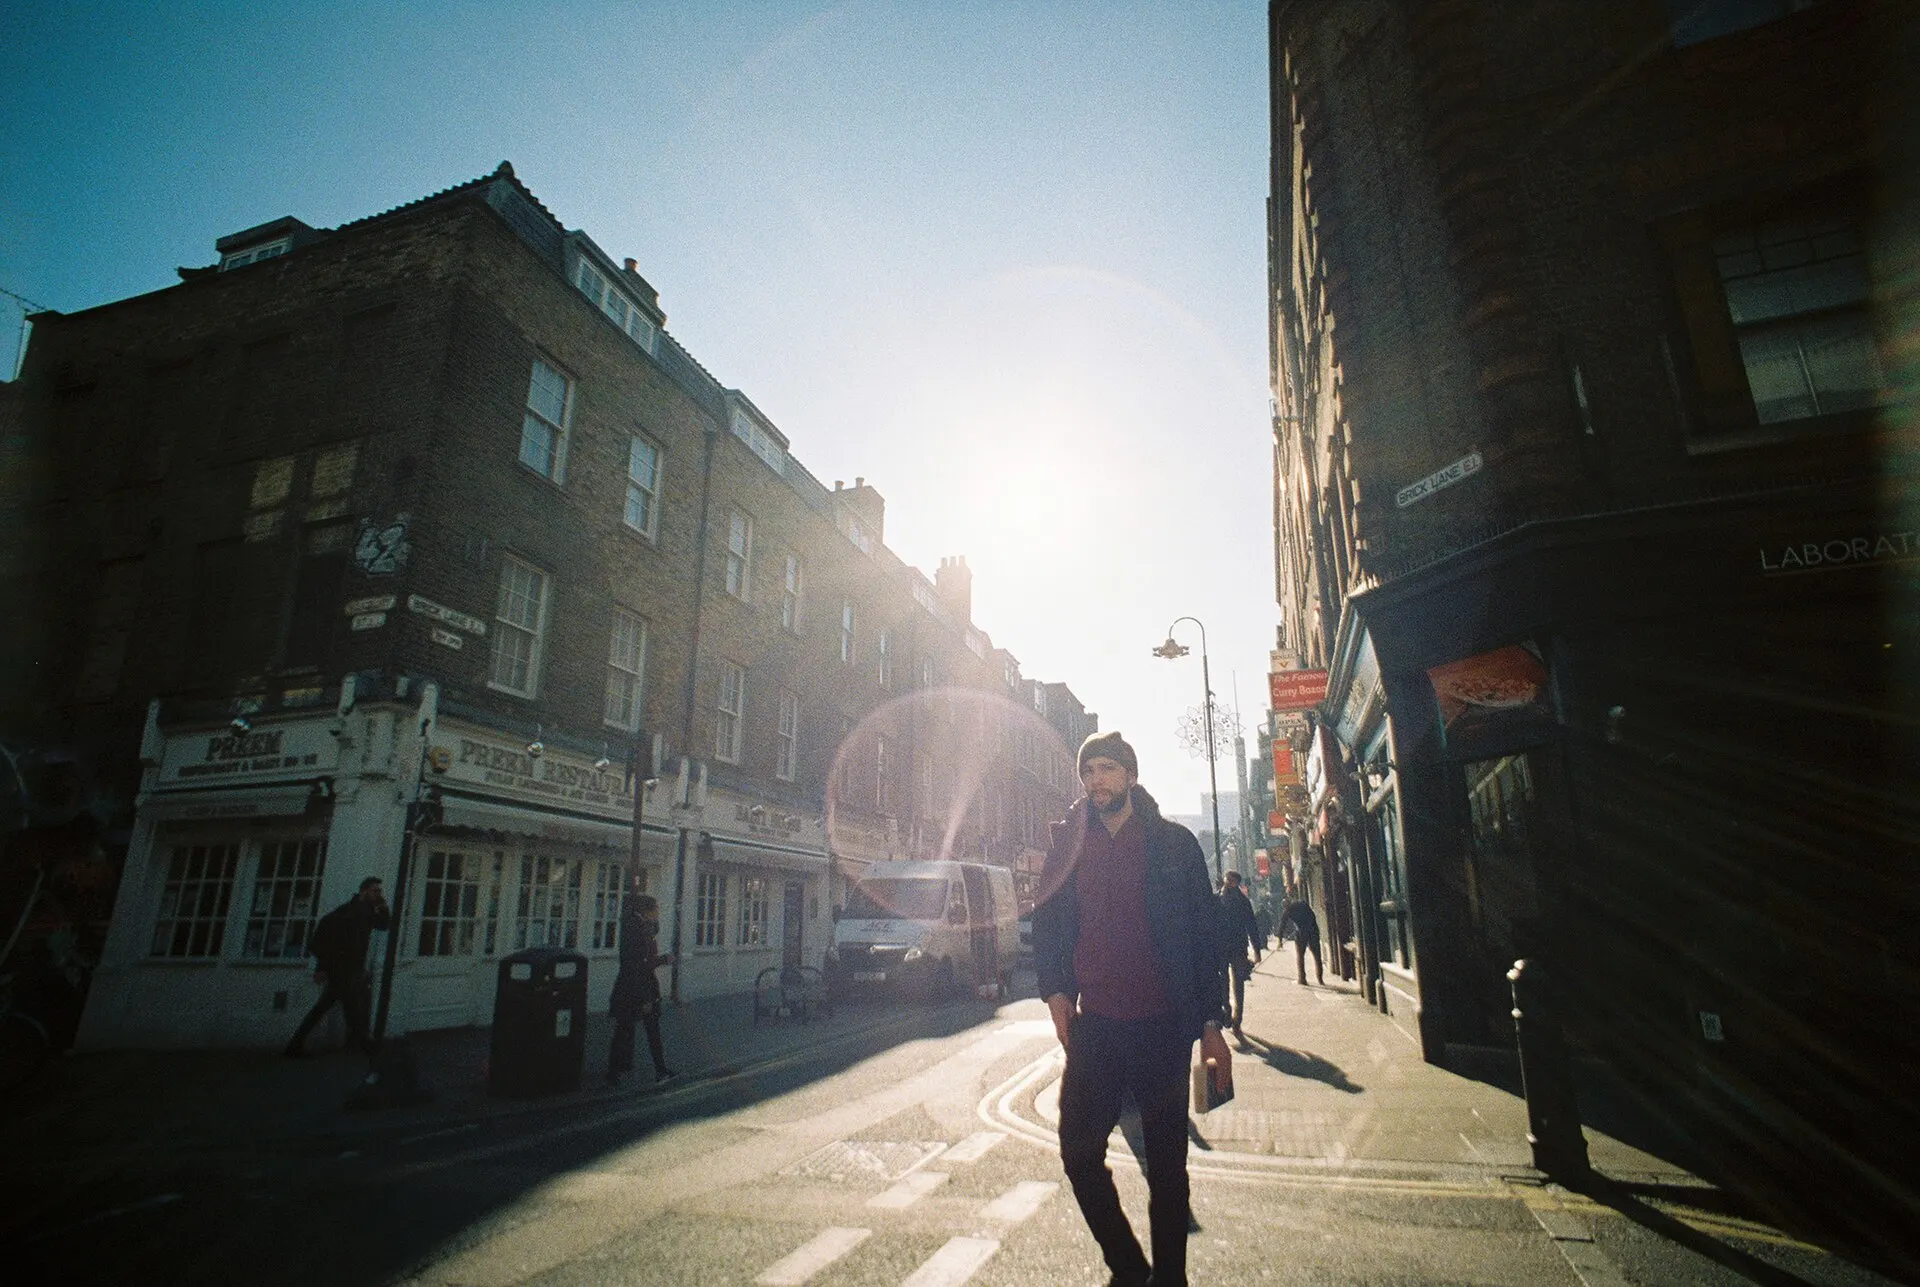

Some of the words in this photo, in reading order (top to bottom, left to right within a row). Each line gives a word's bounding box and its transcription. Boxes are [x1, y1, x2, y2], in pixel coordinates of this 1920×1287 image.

[1399, 480, 1429, 504] BRICK
[1430, 464, 1461, 489] LANE
[1463, 457, 1479, 473] E1
[1760, 531, 1920, 571] LABORAT
[1272, 687, 1298, 699] Curry
[1299, 685, 1327, 695] Bazaa
[1273, 674, 1290, 683] The
[544, 761, 652, 802] RESTAUR
